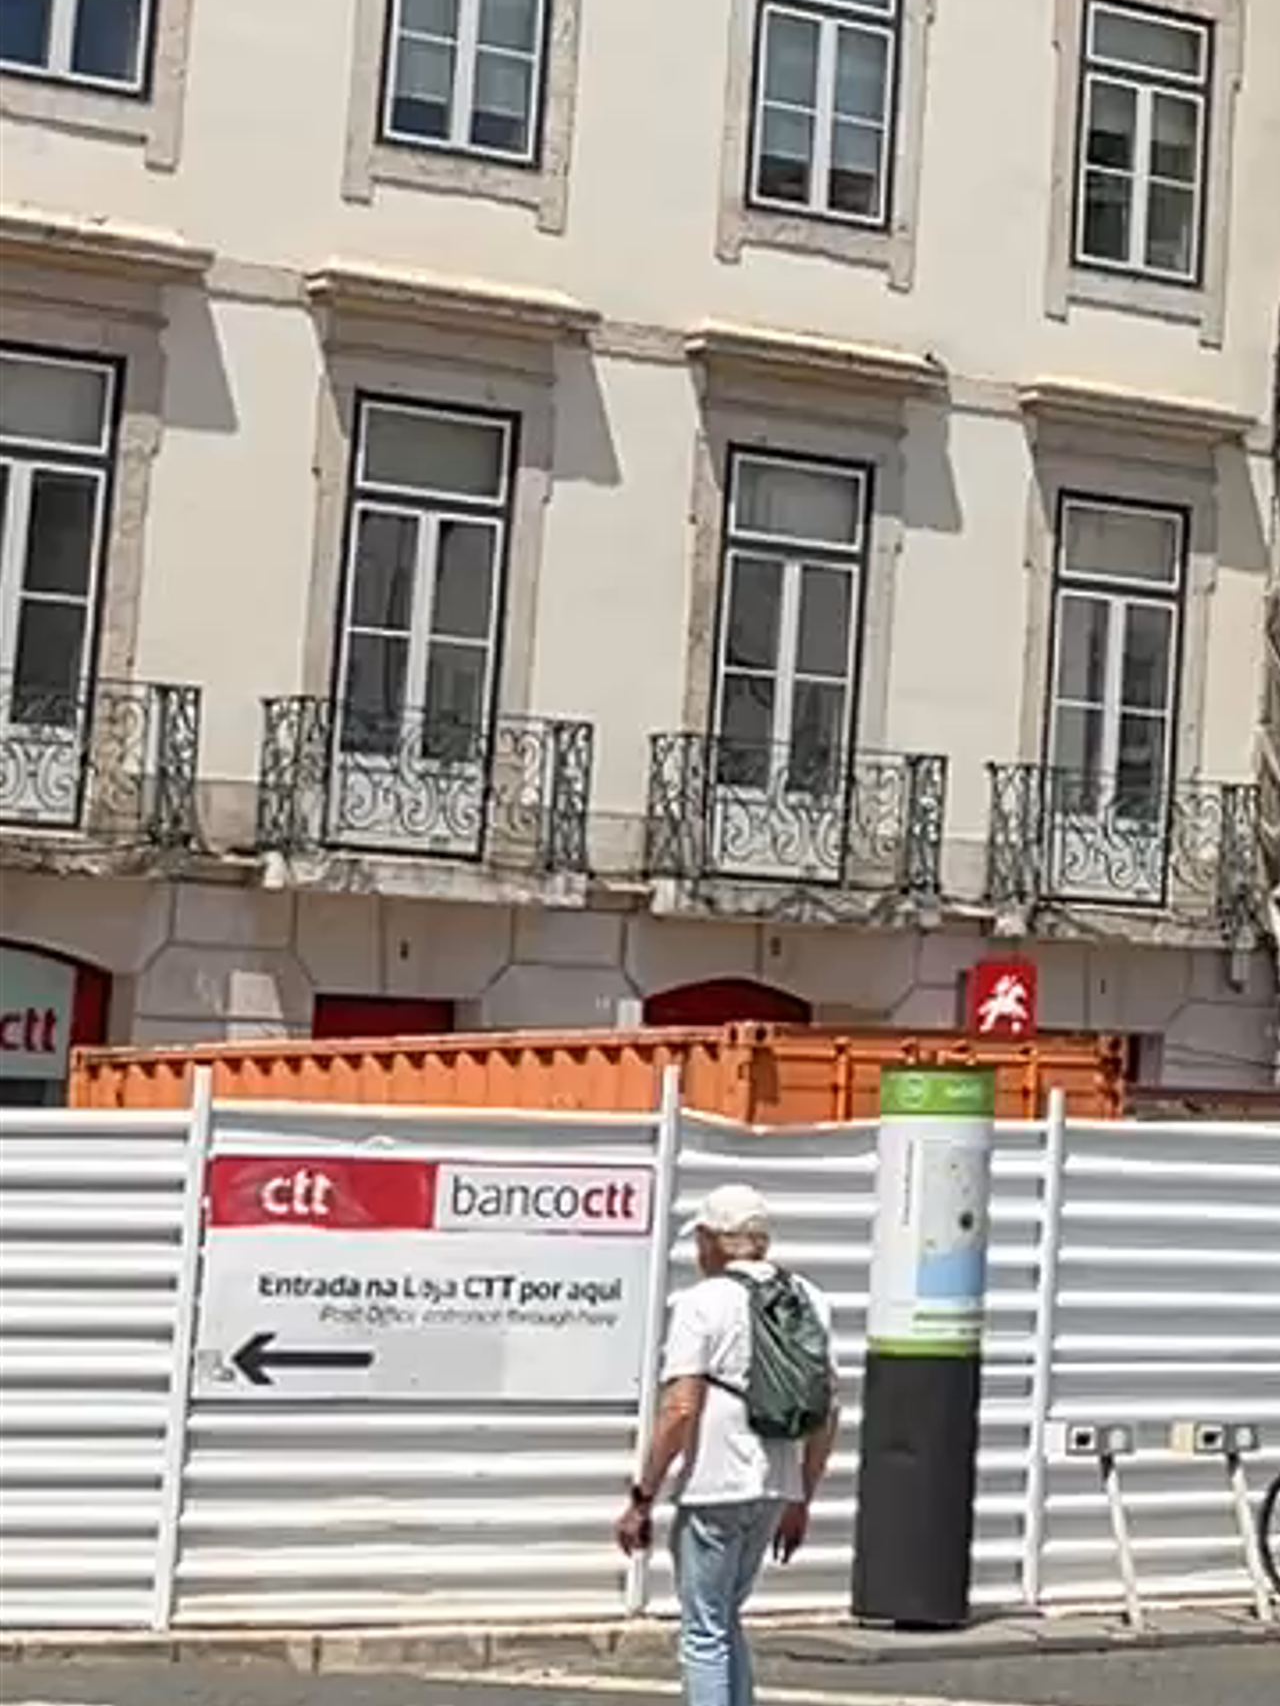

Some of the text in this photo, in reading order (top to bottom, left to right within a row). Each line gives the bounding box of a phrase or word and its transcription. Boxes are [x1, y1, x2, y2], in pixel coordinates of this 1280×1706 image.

[0, 1007, 57, 1054] ctt
[261, 1169, 334, 1215] ctt
[450, 1175, 635, 1220] bancoctt
[258, 1275, 623, 1305] Entrada na Loja CTT por aqui
